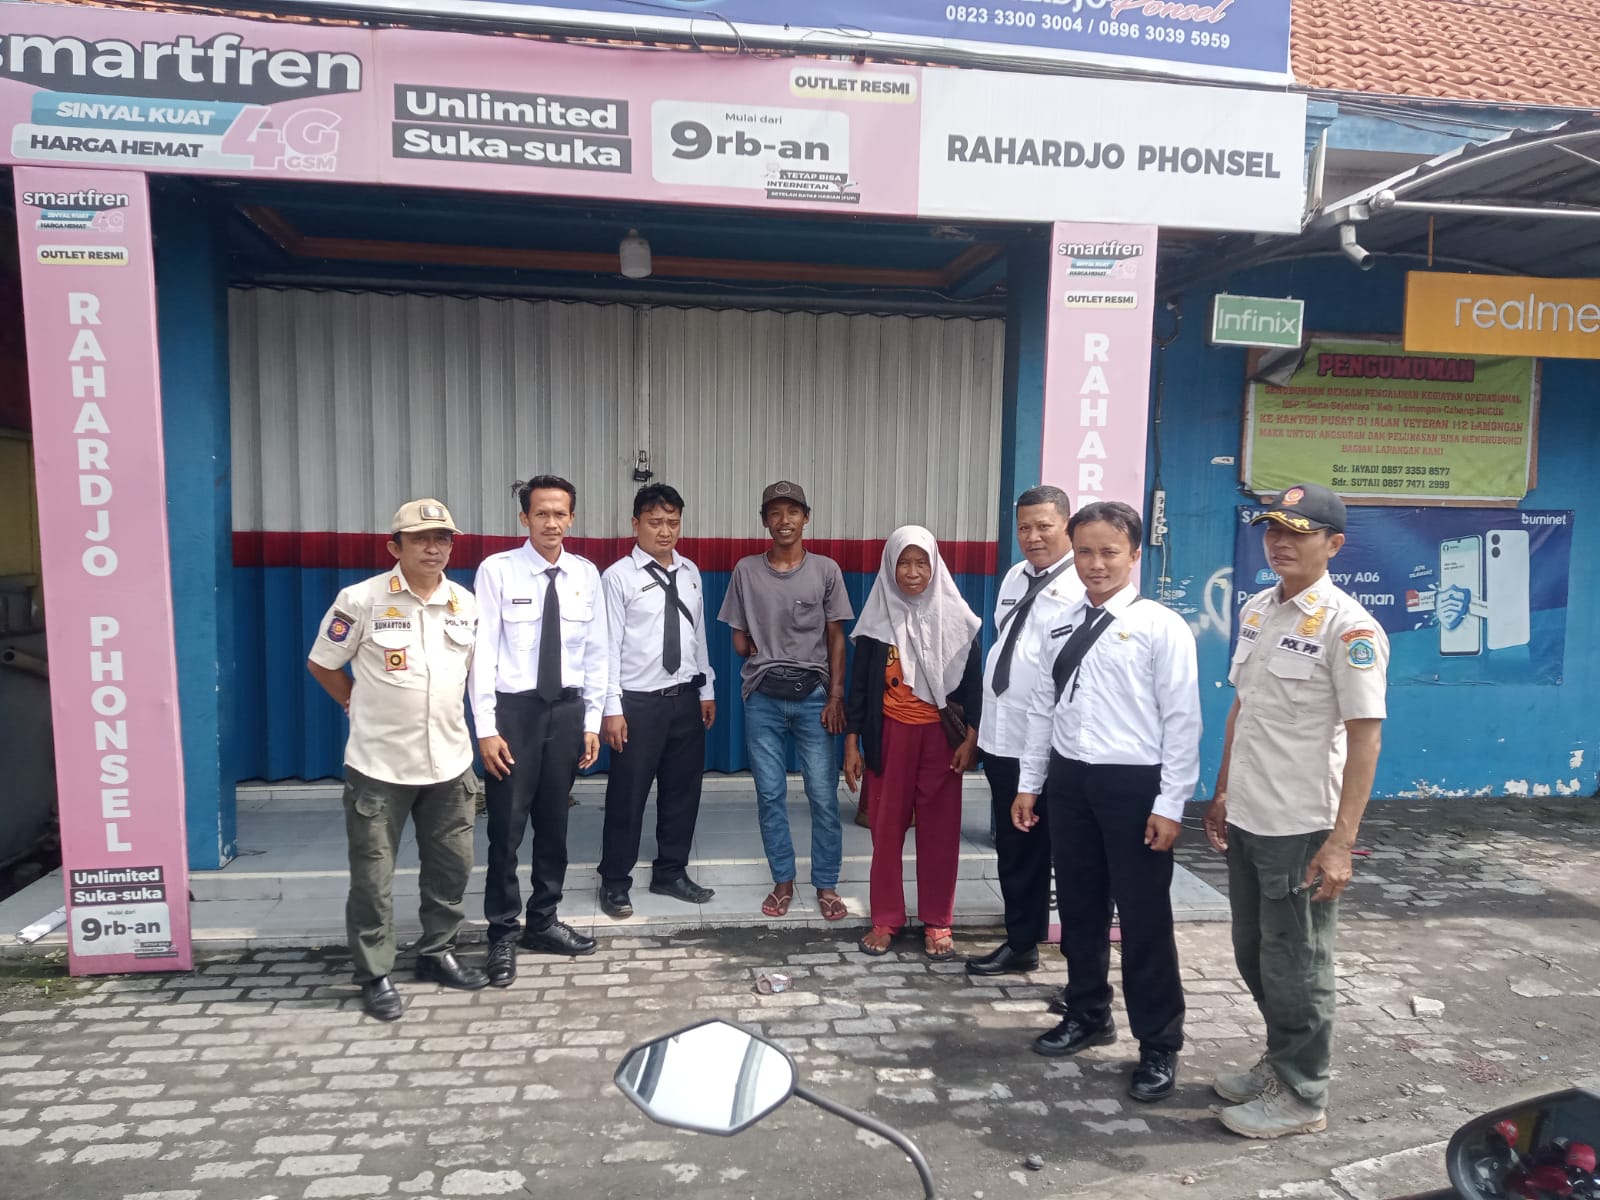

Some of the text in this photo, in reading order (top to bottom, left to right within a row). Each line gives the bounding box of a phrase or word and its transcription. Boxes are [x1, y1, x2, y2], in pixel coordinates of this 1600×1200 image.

[945, 5, 1231, 49] 0823 3300 3004 / 0896 3039 5959
[0, 33, 361, 90] martfren
[794, 75, 910, 95] OUTLET RESMI
[56, 101, 216, 126] SINYAL KUAT
[406, 90, 617, 129] Unlimited
[724, 112, 783, 125] Mulai dari
[30, 133, 203, 158] HARGA HEMAT
[221, 105, 343, 171] 4G
[403, 128, 621, 166] Suka-suka
[670, 120, 830, 161] 9rb-an
[286, 154, 337, 172] GSM
[947, 133, 1281, 179] RAHARDJO PHONSEL
[767, 180, 829, 189] INTERNETAN
[786, 172, 817, 180] TETAP
[23, 190, 129, 206] smartfren
[41, 250, 123, 260] OUTLET RESMI
[1058, 240, 1143, 256] smartfren
[1067, 295, 1134, 304] OUTLET RESMI
[1218, 308, 1297, 334] Infinix
[1455, 292, 1600, 333] realme
[1317, 353, 1475, 382] PENGUMUMAN
[1260, 413, 1273, 423] KE
[1277, 414, 1317, 425] KANTOR
[1321, 415, 1354, 426] PUSAT
[1357, 416, 1367, 426] DI
[1371, 417, 1399, 427] JALAN
[1403, 418, 1448, 429] VETERAN
[1471, 421, 1523, 432] LAMONGAN
[1287, 429, 1316, 439] UNTUK
[1368, 431, 1385, 440] DAN
[1388, 432, 1437, 442] PELUNASAN
[1332, 464, 1349, 473] Sdr.
[1381, 465, 1403, 474] 0857
[1405, 466, 1427, 475] 3353
[1331, 478, 1348, 487] Sdr.
[1382, 479, 1403, 488] 0857
[1405, 480, 1425, 488] 7471
[1521, 513, 1567, 525] buminet
[68, 292, 132, 852] RAHARDJO PHONSEL
[1355, 571, 1380, 583] A06
[1281, 637, 1319, 654] POL PP
[74, 868, 160, 885] Unlimited
[74, 887, 162, 903] Suka-suka
[81, 917, 161, 942] 9rb-an
